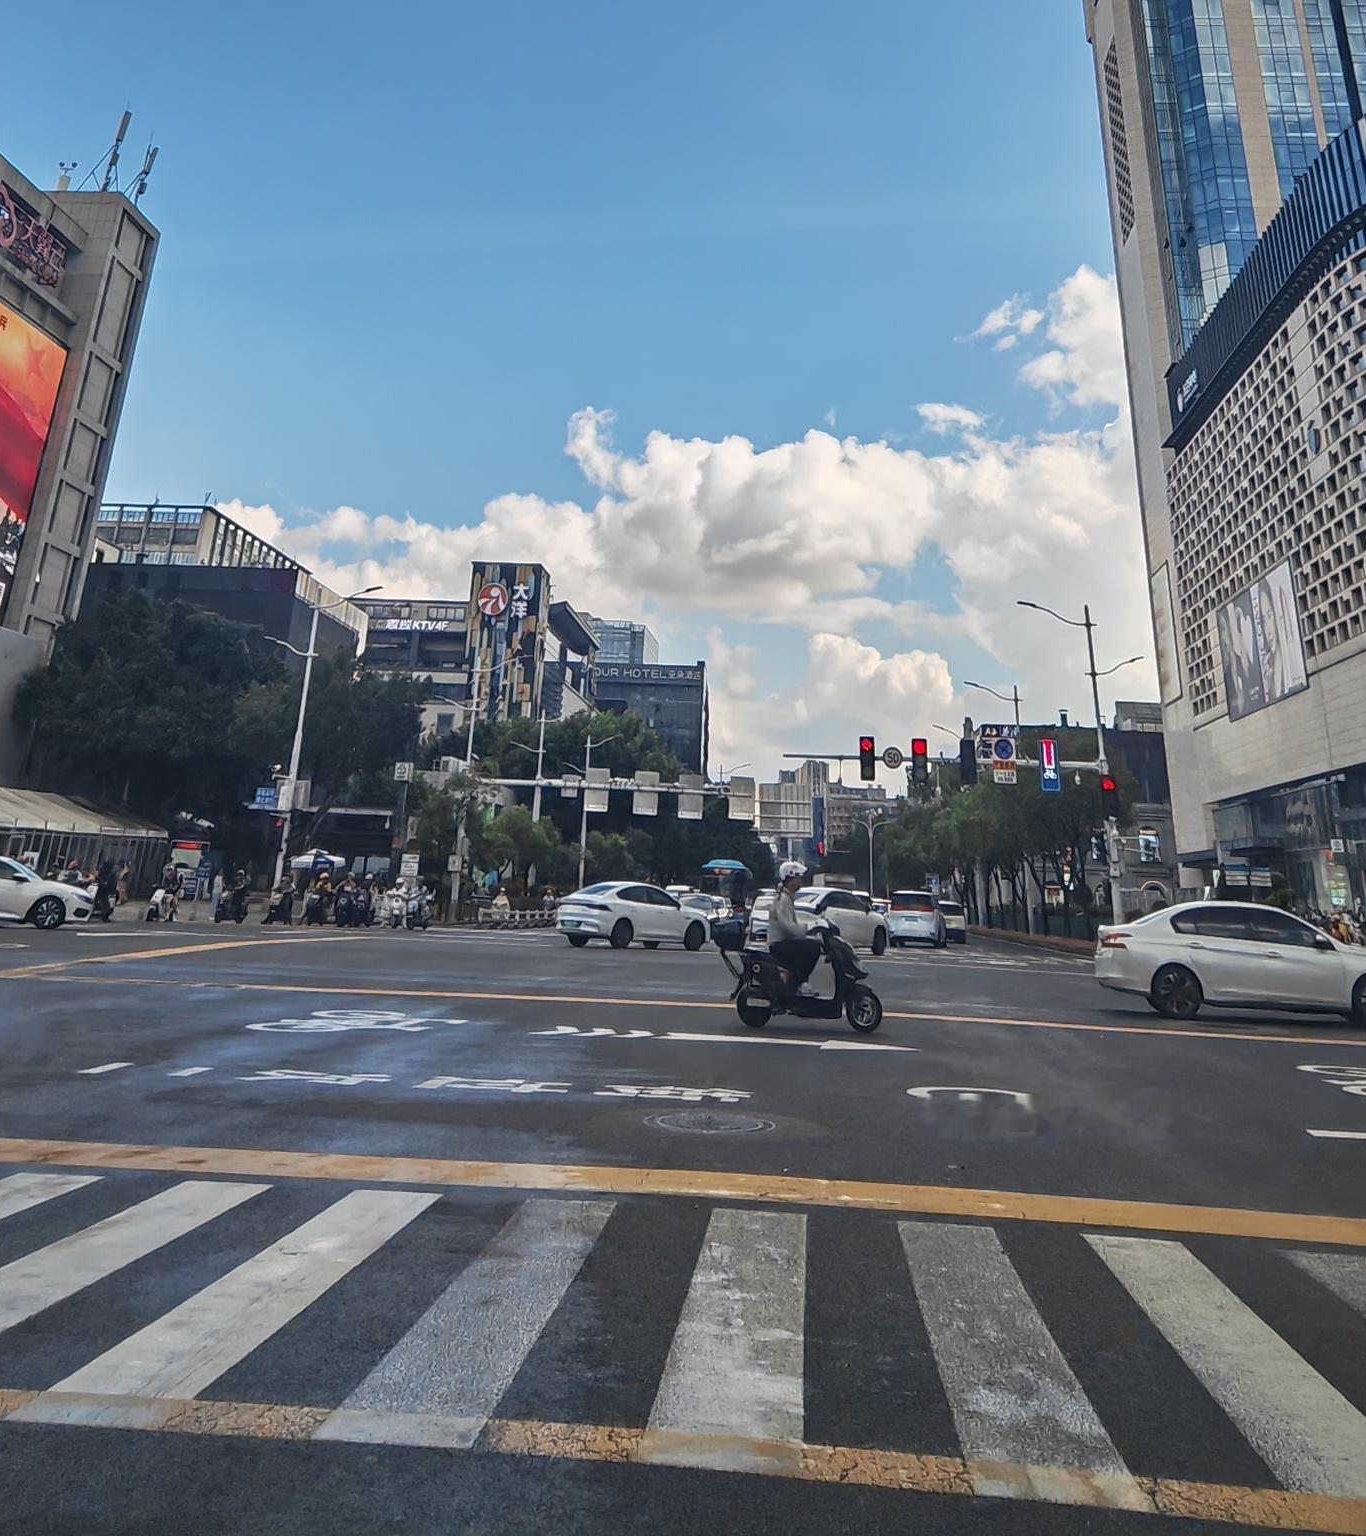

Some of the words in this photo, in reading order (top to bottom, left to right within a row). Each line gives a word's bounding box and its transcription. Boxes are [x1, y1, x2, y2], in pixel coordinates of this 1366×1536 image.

[510, 583, 529, 619] 大洋
[623, 667, 667, 680] HOTEL
[886, 751, 900, 763] 50
